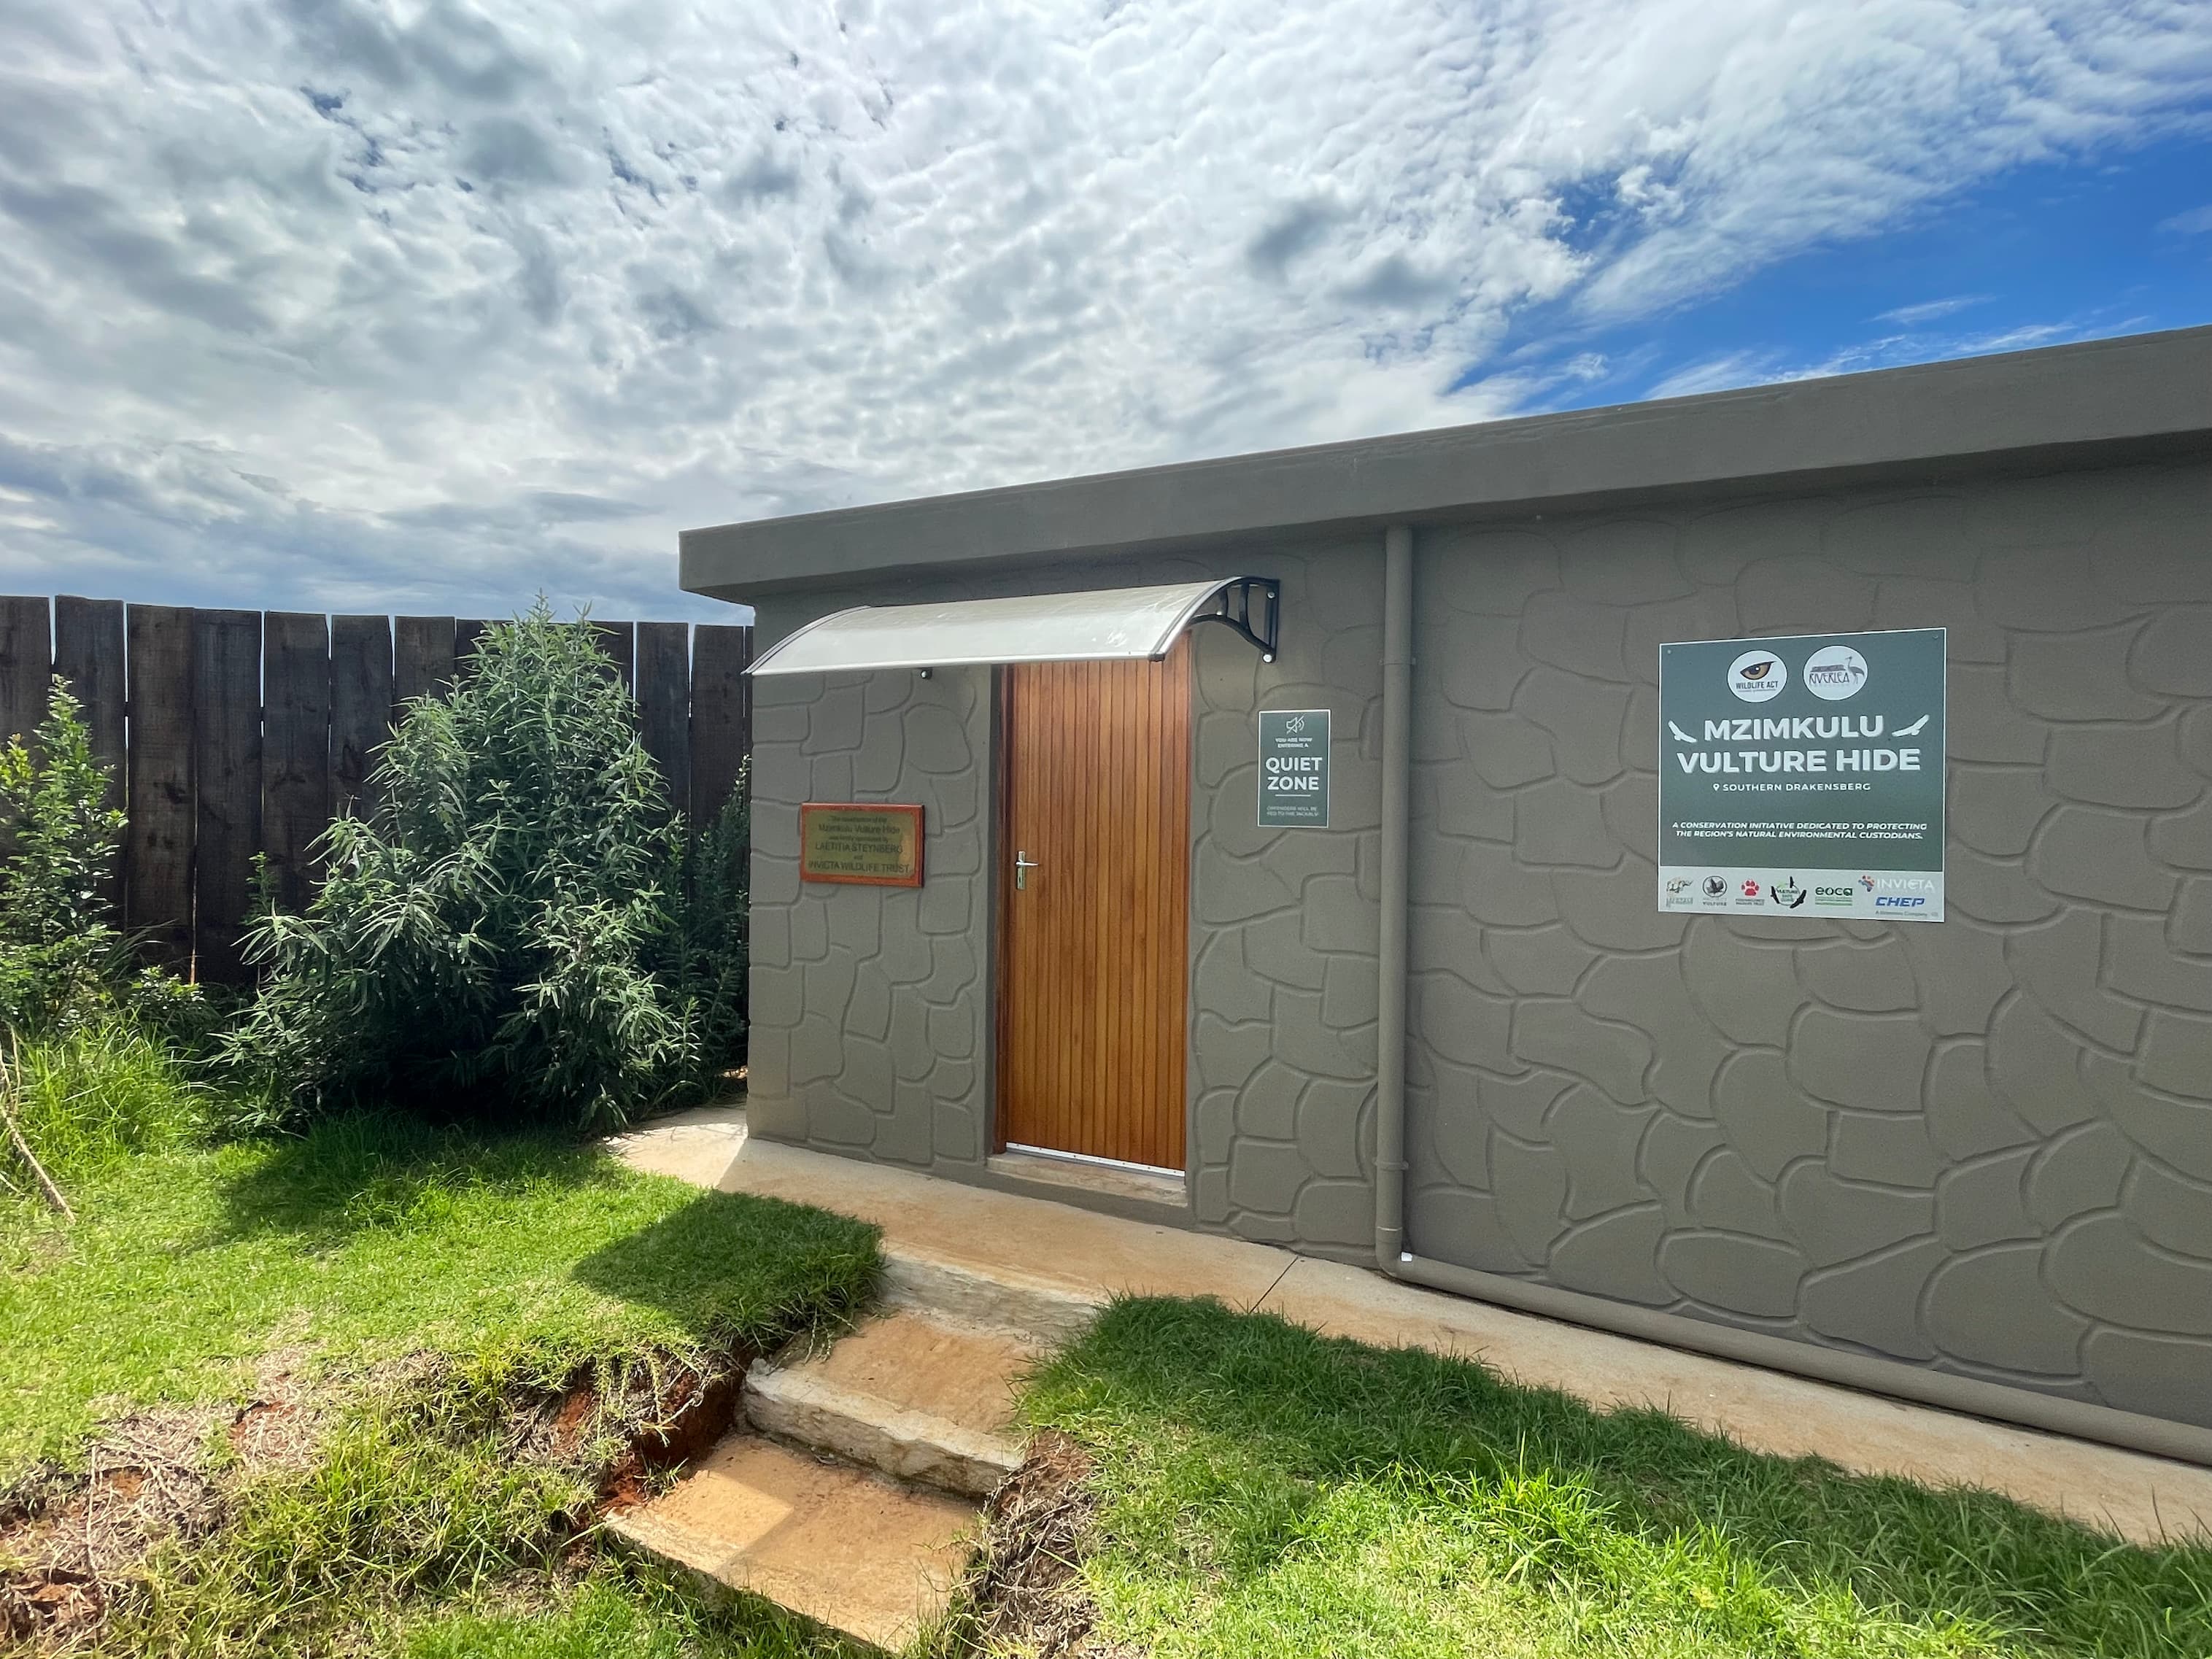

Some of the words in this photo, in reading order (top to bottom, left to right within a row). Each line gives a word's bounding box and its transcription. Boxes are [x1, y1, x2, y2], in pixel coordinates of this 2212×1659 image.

[1809, 672, 1849, 684] RIVERLEA
[1704, 716, 1884, 740] MZIMKULU
[1266, 757, 1323, 773] QUIET
[1677, 750, 1828, 773] VULTURE
[1836, 748, 1921, 772] HIDE
[1267, 776, 1319, 790] ZONE
[1722, 784, 1782, 792] SOUTHERN
[1786, 783, 1871, 791] DRAKENSBERG
[881, 863, 910, 873] TRUST
[1877, 878, 1934, 889] INVICTA
[1815, 886, 1853, 896] eoca
[1875, 897, 1925, 907] CHEP
